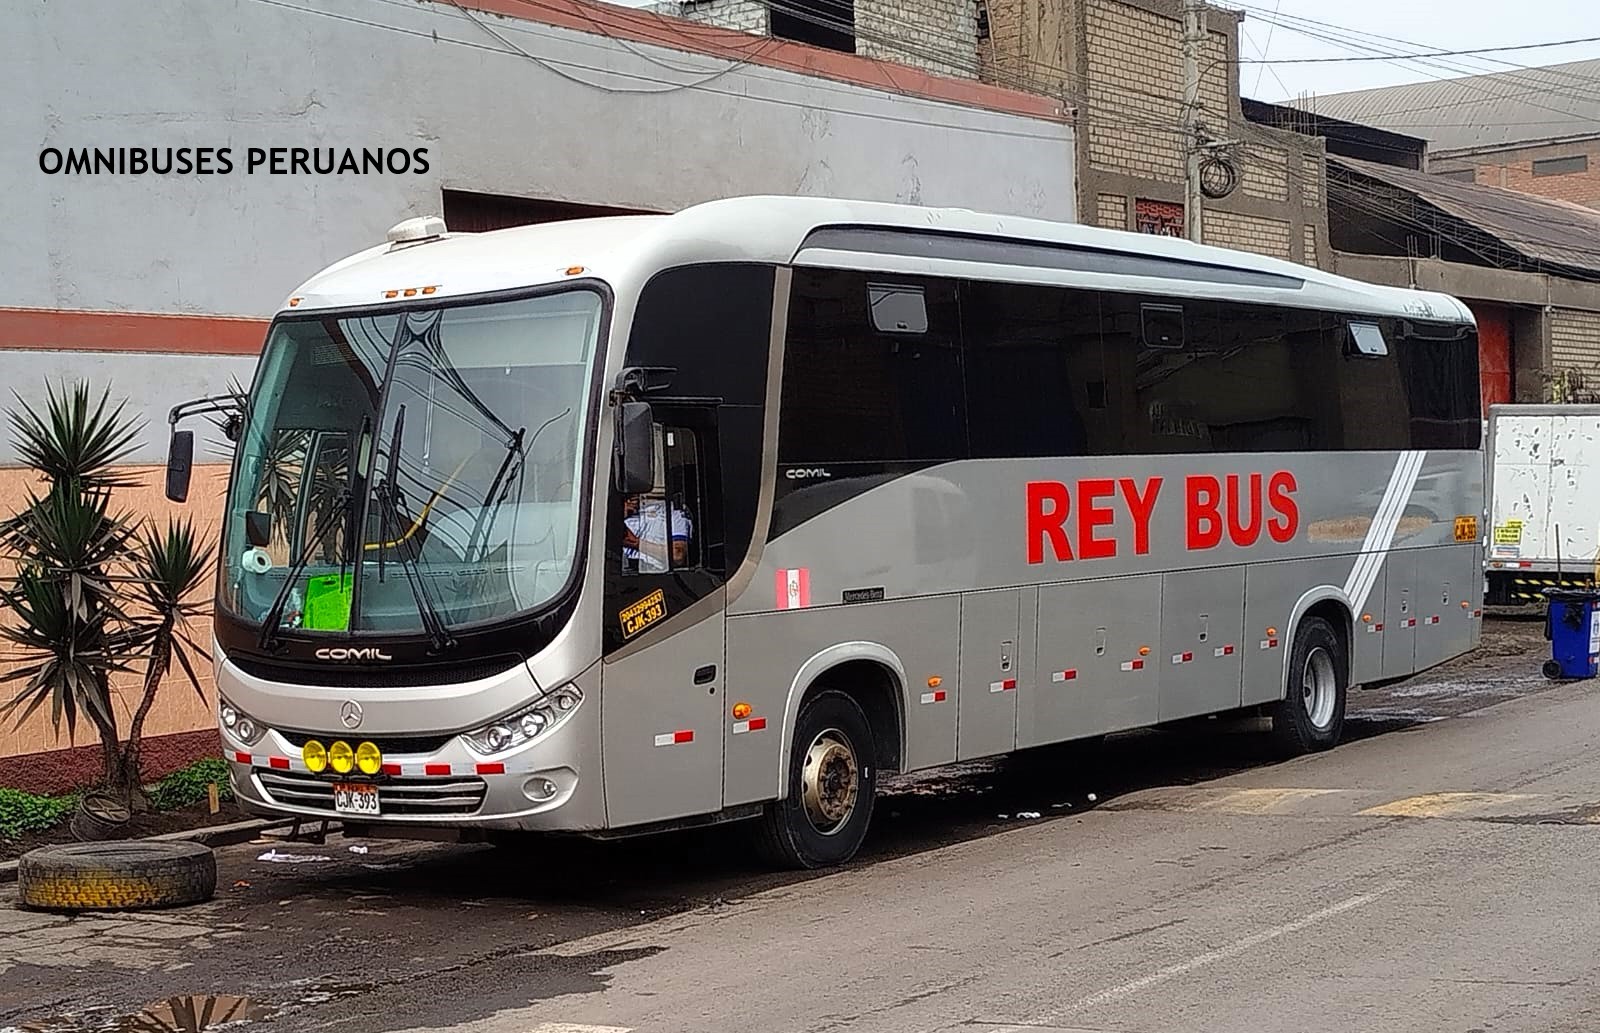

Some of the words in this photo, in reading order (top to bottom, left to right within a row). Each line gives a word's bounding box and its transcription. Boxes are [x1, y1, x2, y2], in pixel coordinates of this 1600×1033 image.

[785, 468, 832, 479] COMIL
[1026, 475, 1164, 565] REY
[1185, 470, 1301, 551] BUS
[627, 604, 663, 633] CJK-393
[315, 647, 393, 661] COMIL
[336, 790, 378, 810] CJK-393
